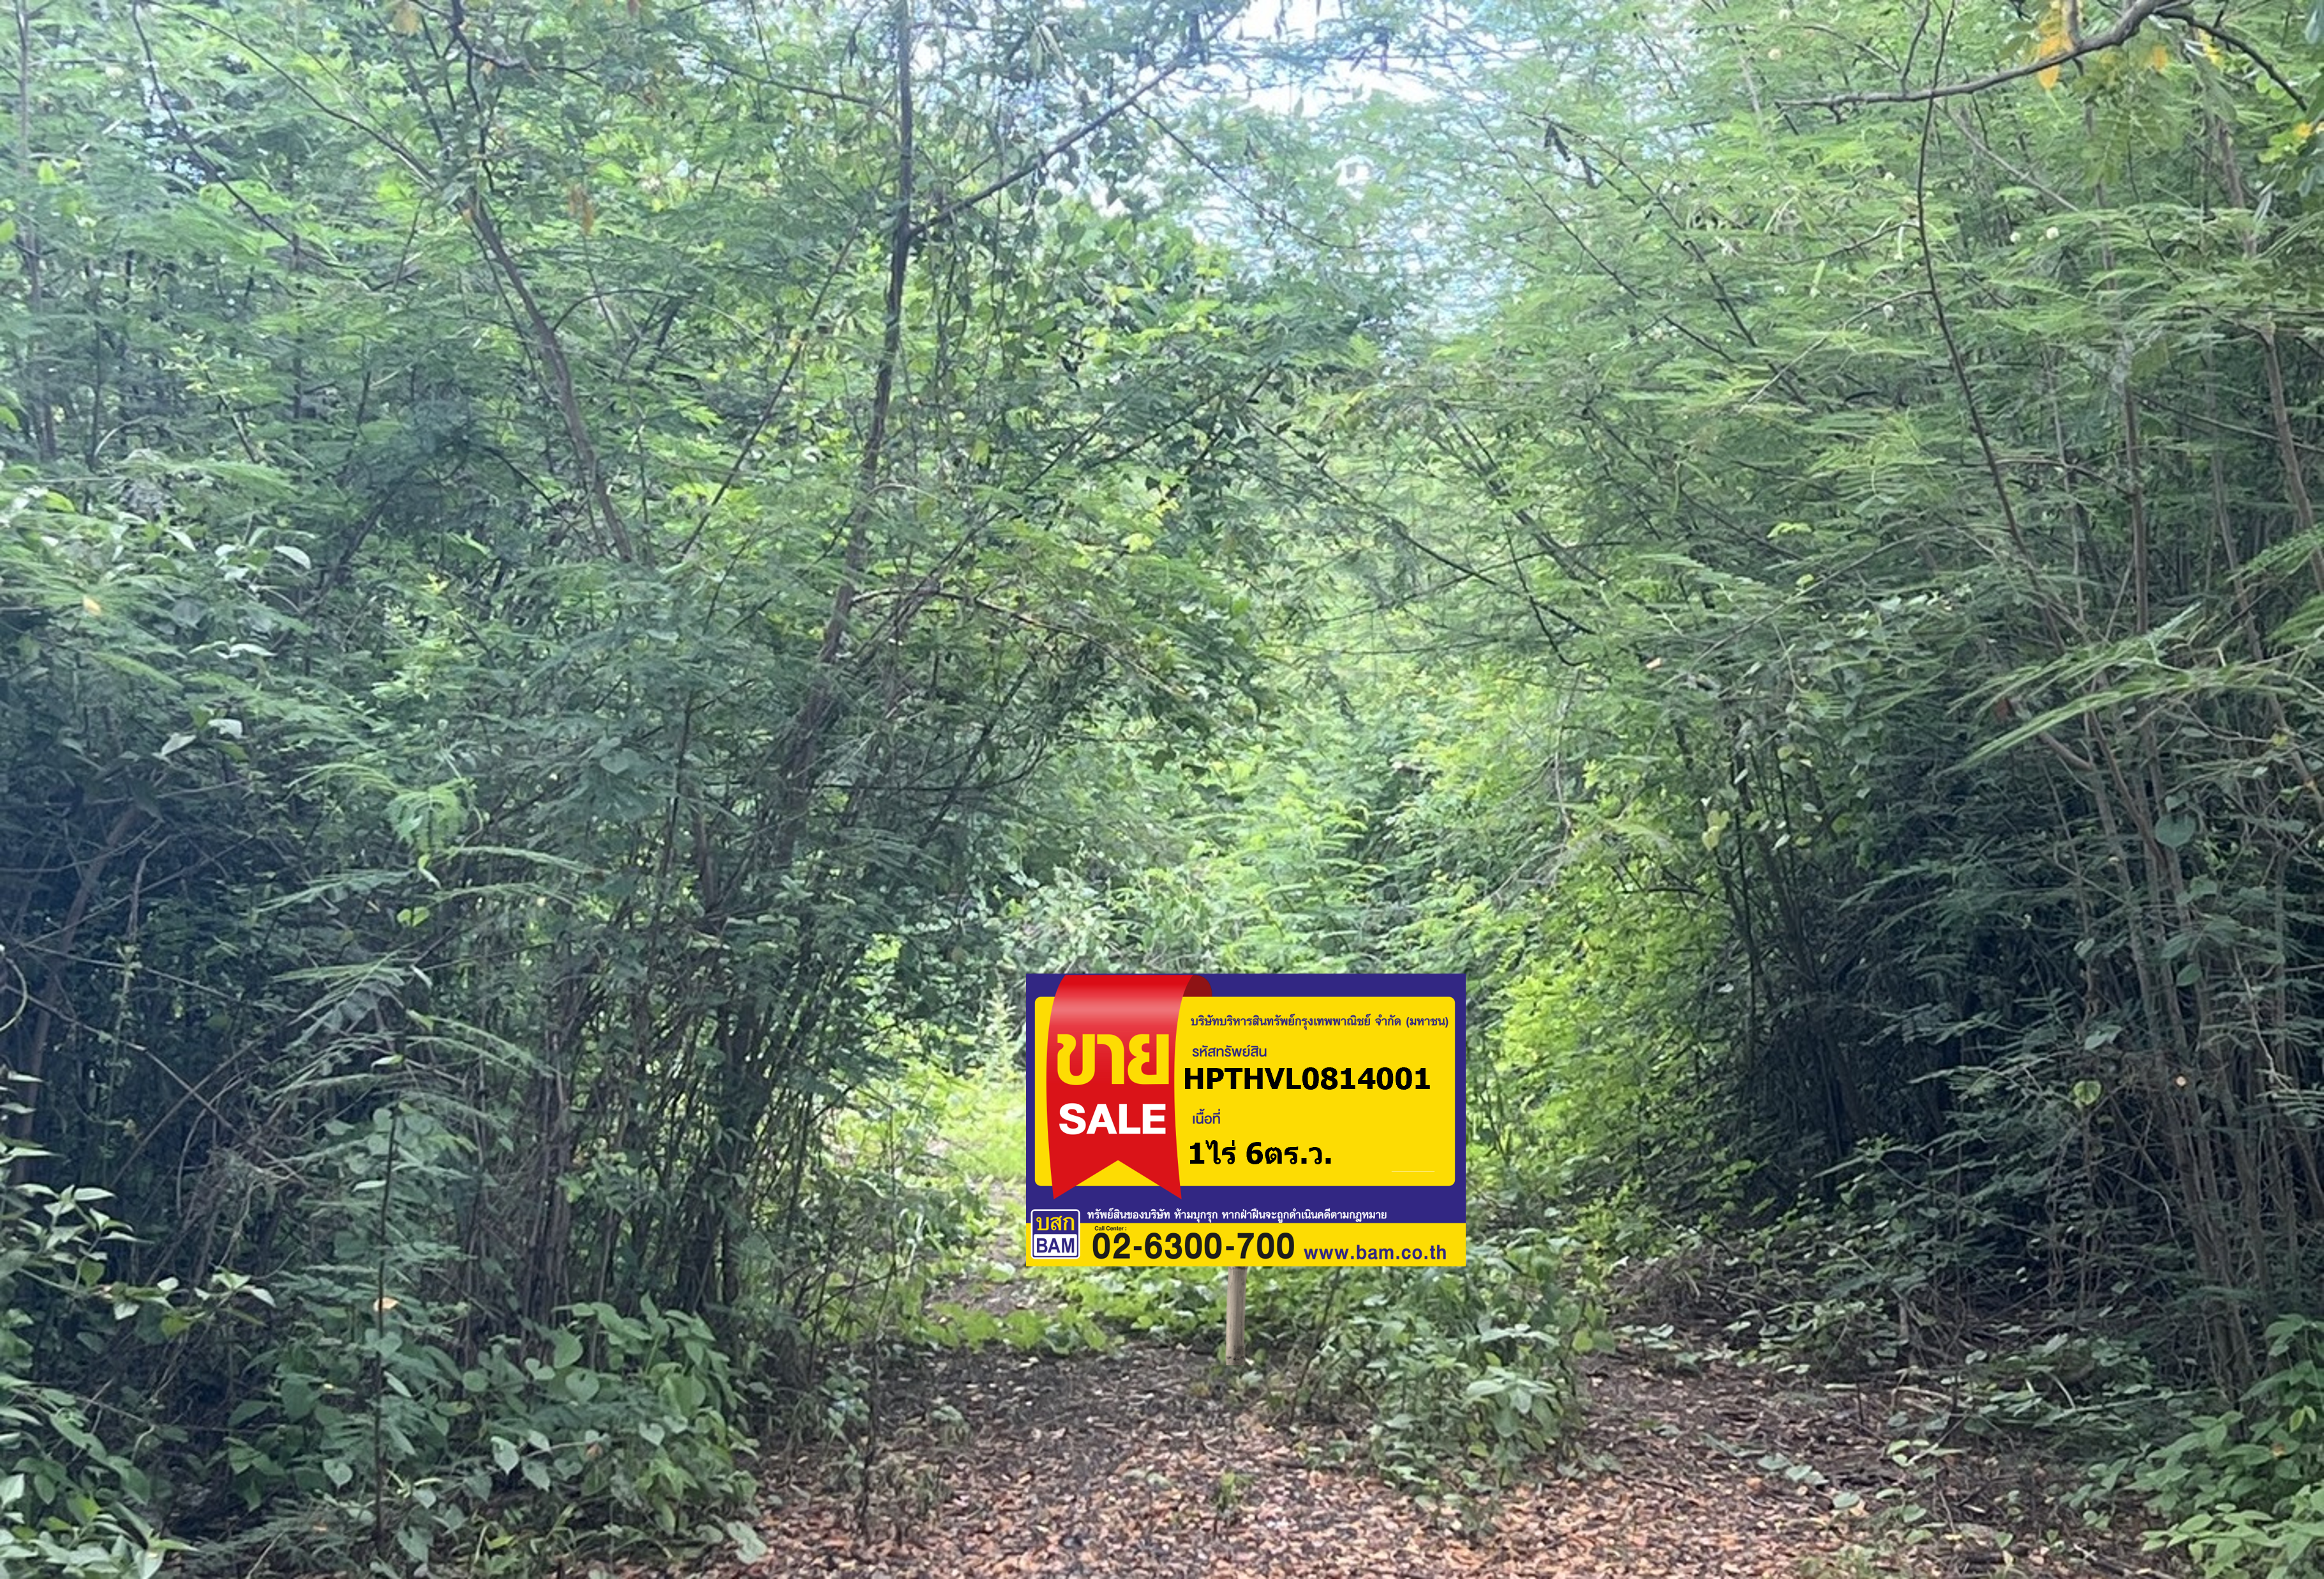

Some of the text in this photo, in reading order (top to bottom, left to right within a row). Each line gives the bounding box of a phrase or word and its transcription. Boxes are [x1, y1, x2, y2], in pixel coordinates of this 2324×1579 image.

[1190, 1013, 1449, 1030] บริษัทบริหารสินทรัพย์กรุงเทพพาณิชย์ จำกัด (มหาชน)
[1192, 1044, 1267, 1057] รหัสทรัพย์สิน
[1057, 1034, 1170, 1086] ขาย
[1184, 1067, 1431, 1090] HPTHVL0814001
[1059, 1102, 1166, 1135] SALE
[1193, 1108, 1221, 1125] เนื้อที่
[1189, 1139, 1332, 1165] 1ไร่ 6ตร.ว.
[1036, 1215, 1075, 1231] บสก
[1087, 1207, 1387, 1223] ทรัพย์สินของบริษัท ห้ามบุกรุก หากฝ่าฝืนจะถูกดำเนินคดีตามกฎหมาย
[1036, 1238, 1075, 1254] BAM
[1092, 1232, 1295, 1259] 02-6300-700
[1303, 1244, 1447, 1260] www.bam.co.th
